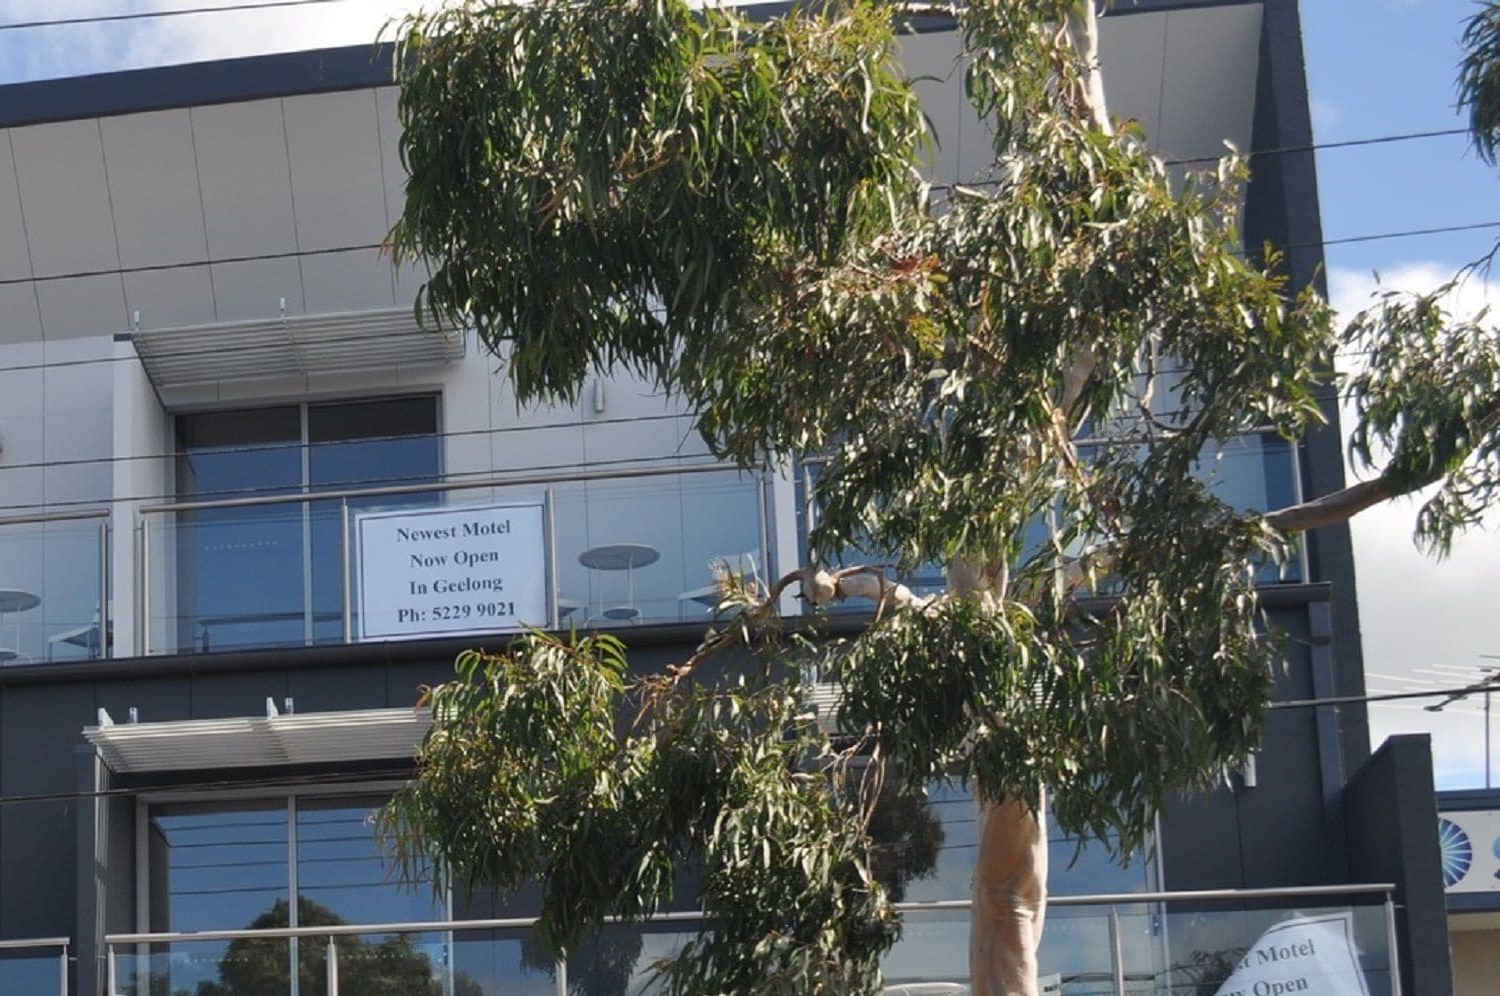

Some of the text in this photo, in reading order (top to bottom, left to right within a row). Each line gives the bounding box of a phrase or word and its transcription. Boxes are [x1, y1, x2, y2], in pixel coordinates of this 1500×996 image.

[396, 519, 511, 543] Newest Motel
[409, 550, 499, 569] Now Open
[409, 576, 503, 596] In Geelong
[397, 601, 515, 624] Ph: 5229 9021
[1256, 938, 1316, 966] Motel
